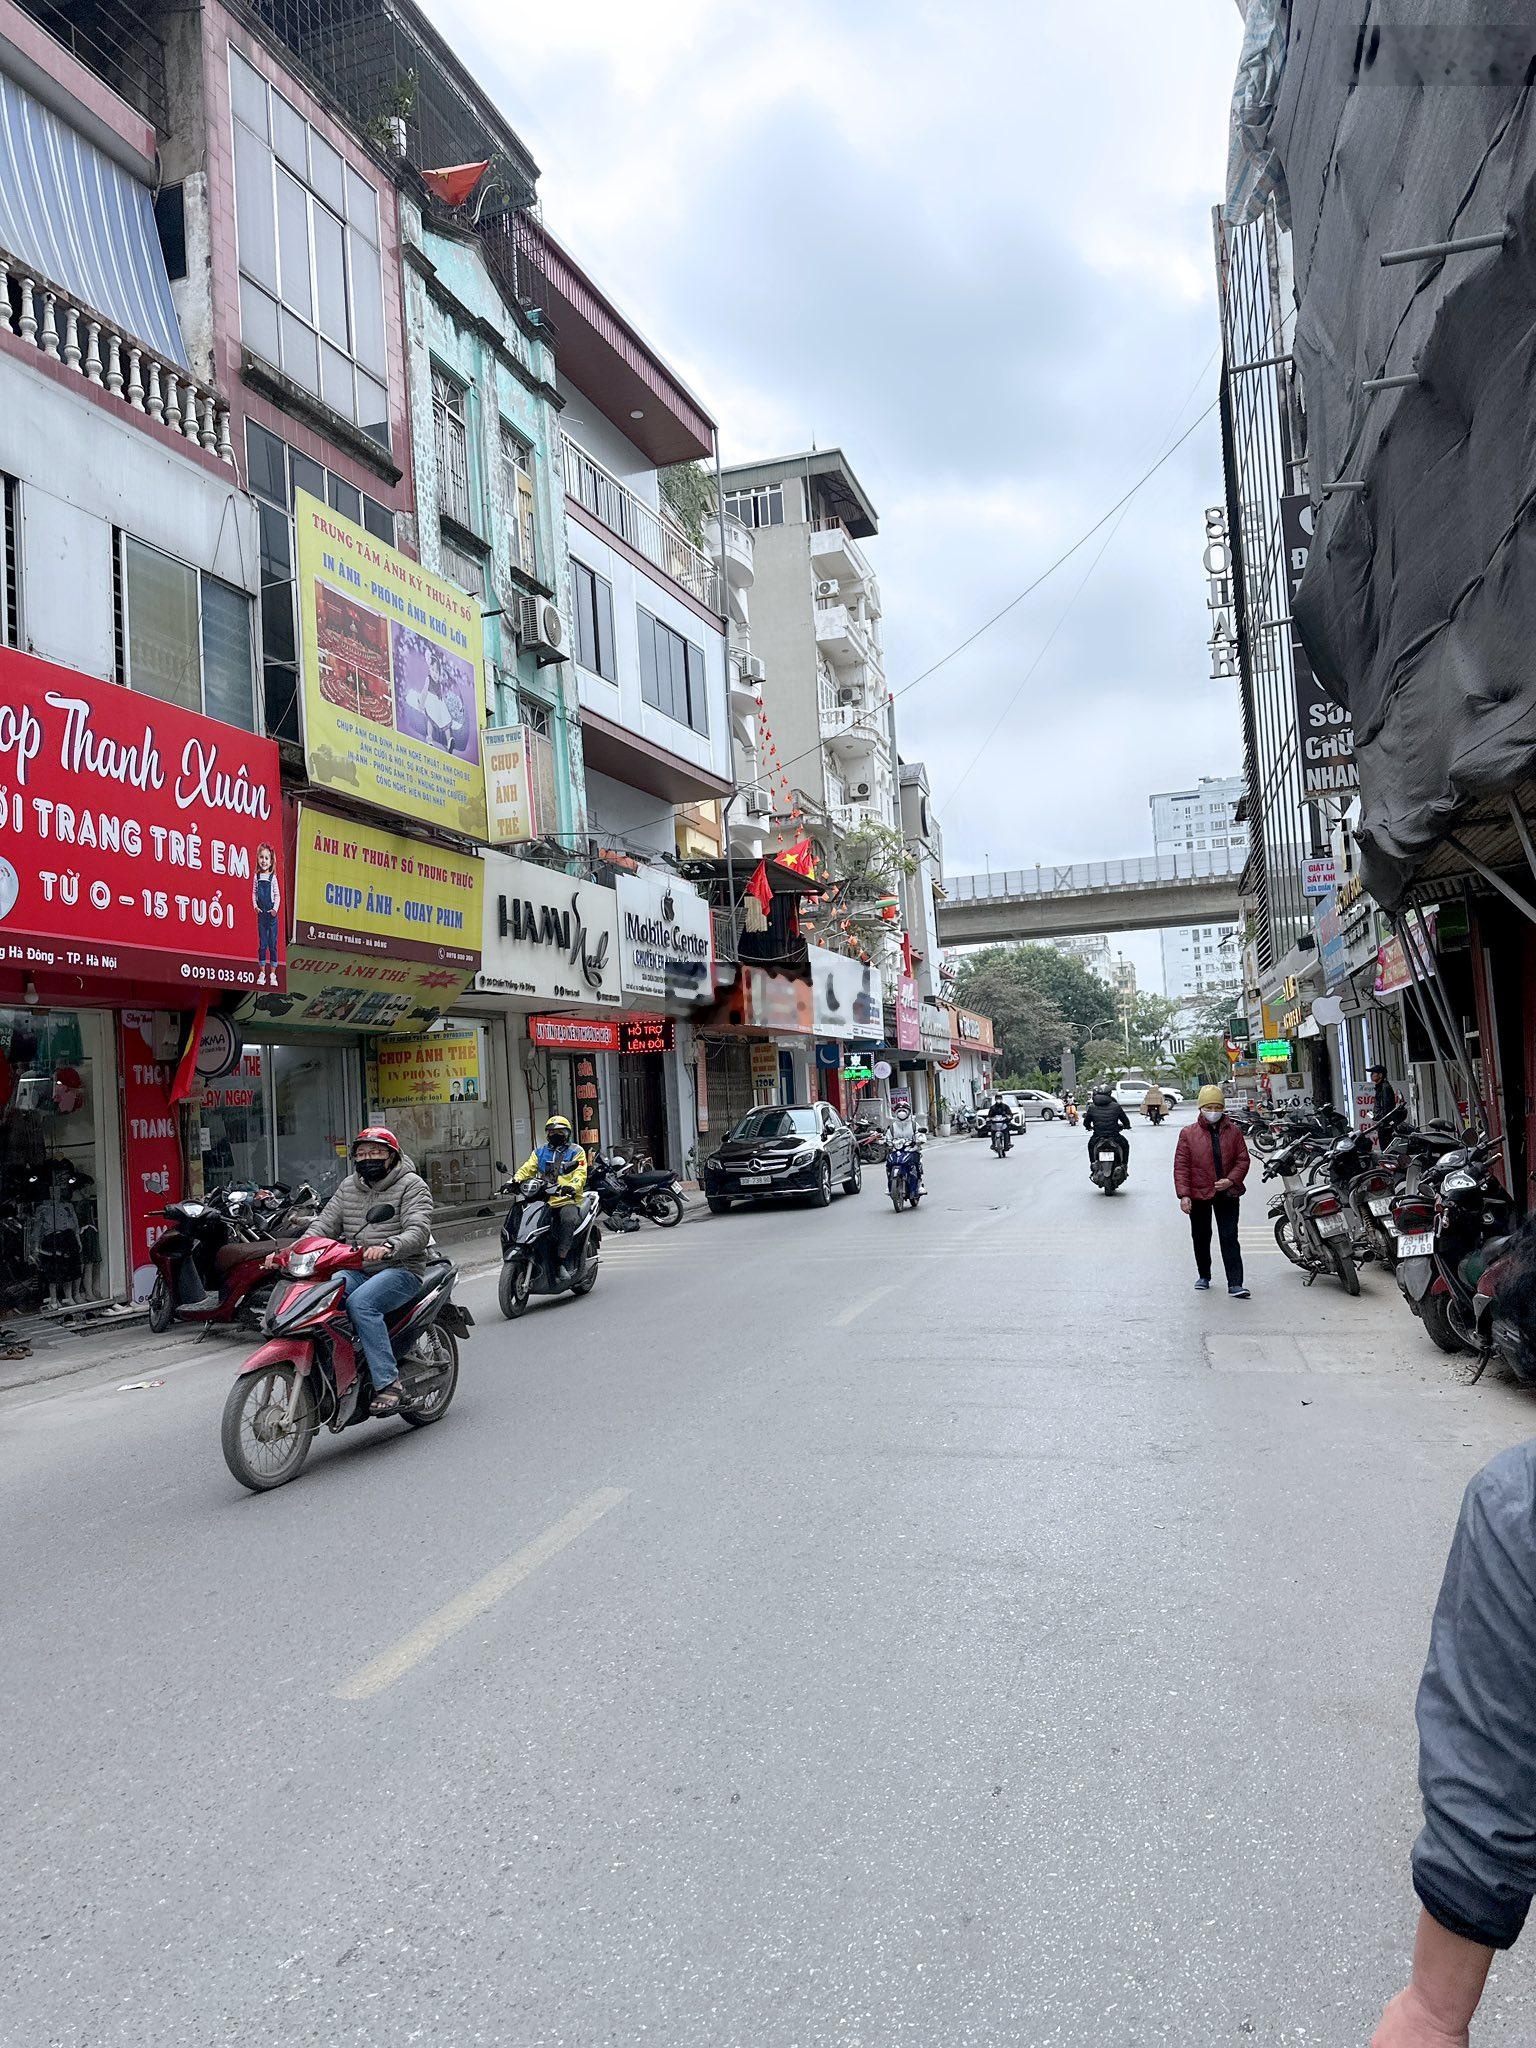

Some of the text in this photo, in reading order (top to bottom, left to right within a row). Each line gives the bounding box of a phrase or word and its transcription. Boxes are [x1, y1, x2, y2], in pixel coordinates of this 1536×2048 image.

[312, 513, 472, 622] TRUNG TÂM ẢNH KỸ THUẬT SỐ
[323, 552, 335, 572] IN
[371, 581, 404, 612] PHÓNG
[450, 627, 467, 649] LỚN
[1203, 506, 1240, 680] SOLAR
[44, 691, 165, 792] Thanh
[175, 738, 271, 822] Xuân
[496, 780, 518, 804] ẢNH
[497, 810, 519, 836] THẺ
[32, 798, 142, 858] TRANG
[149, 823, 202, 870] TRẺ
[210, 839, 250, 880] EM
[314, 830, 474, 891] ẢNH KỸ THUẬT SỐ TRUNG THỰC
[39, 869, 80, 907] TỪ
[142, 888, 168, 920] 15
[175, 890, 235, 930] TUỔI
[325, 883, 463, 929] CHỤP ẢNH QUAY PHIM
[625, 911, 708, 956] Mobile Center
[9, 945, 23, 959] Hà
[27, 947, 54, 965] Đông
[67, 952, 83, 965] TP.
[86, 954, 99, 967] Hà
[102, 956, 117, 970] Nội
[191, 967, 255, 984] 0913 033 450
[290, 958, 340, 975] CHỤP
[341, 959, 377, 978] ẢNH
[377, 967, 412, 984] THẺ
[379, 1040, 476, 1067] CHỤP ẢNH THẺ
[628, 1038, 646, 1050] LÊN
[402, 1066, 440, 1080] PHÓNG
[225, 1089, 254, 1106] NGAY
[130, 1118, 175, 1139] TRANG
[1400, 1243, 1432, 1256] 137.69
